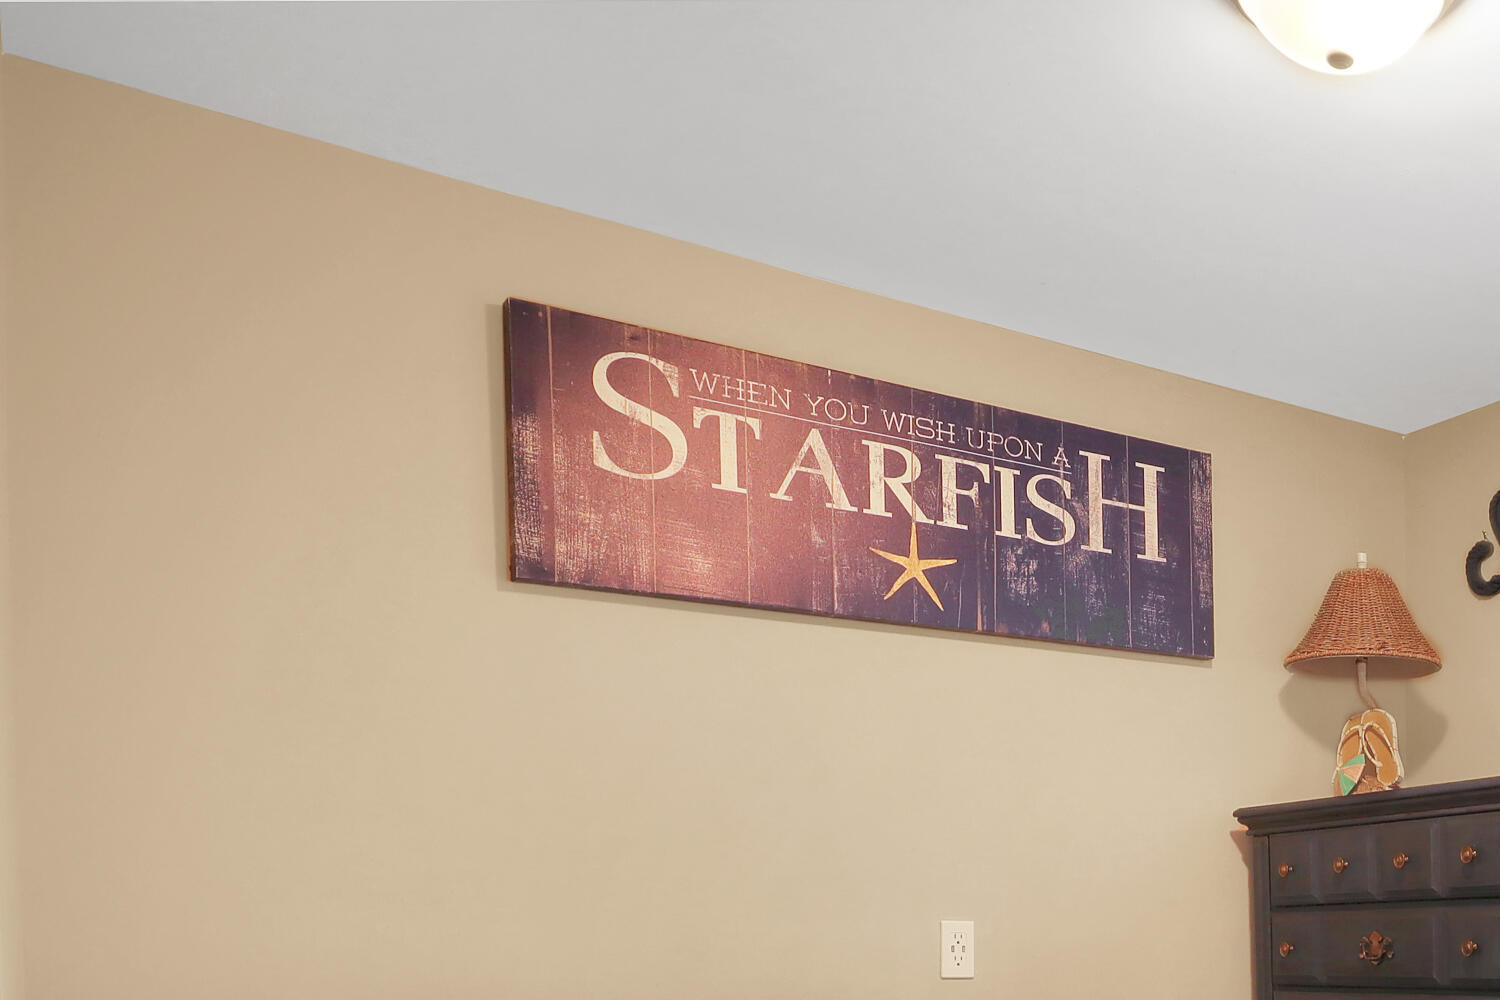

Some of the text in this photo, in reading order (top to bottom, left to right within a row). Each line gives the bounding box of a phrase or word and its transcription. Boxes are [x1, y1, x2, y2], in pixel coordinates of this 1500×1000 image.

[591, 351, 1167, 563] STARFISH
[690, 368, 1072, 469] WHEN YOU WISH UPON A
